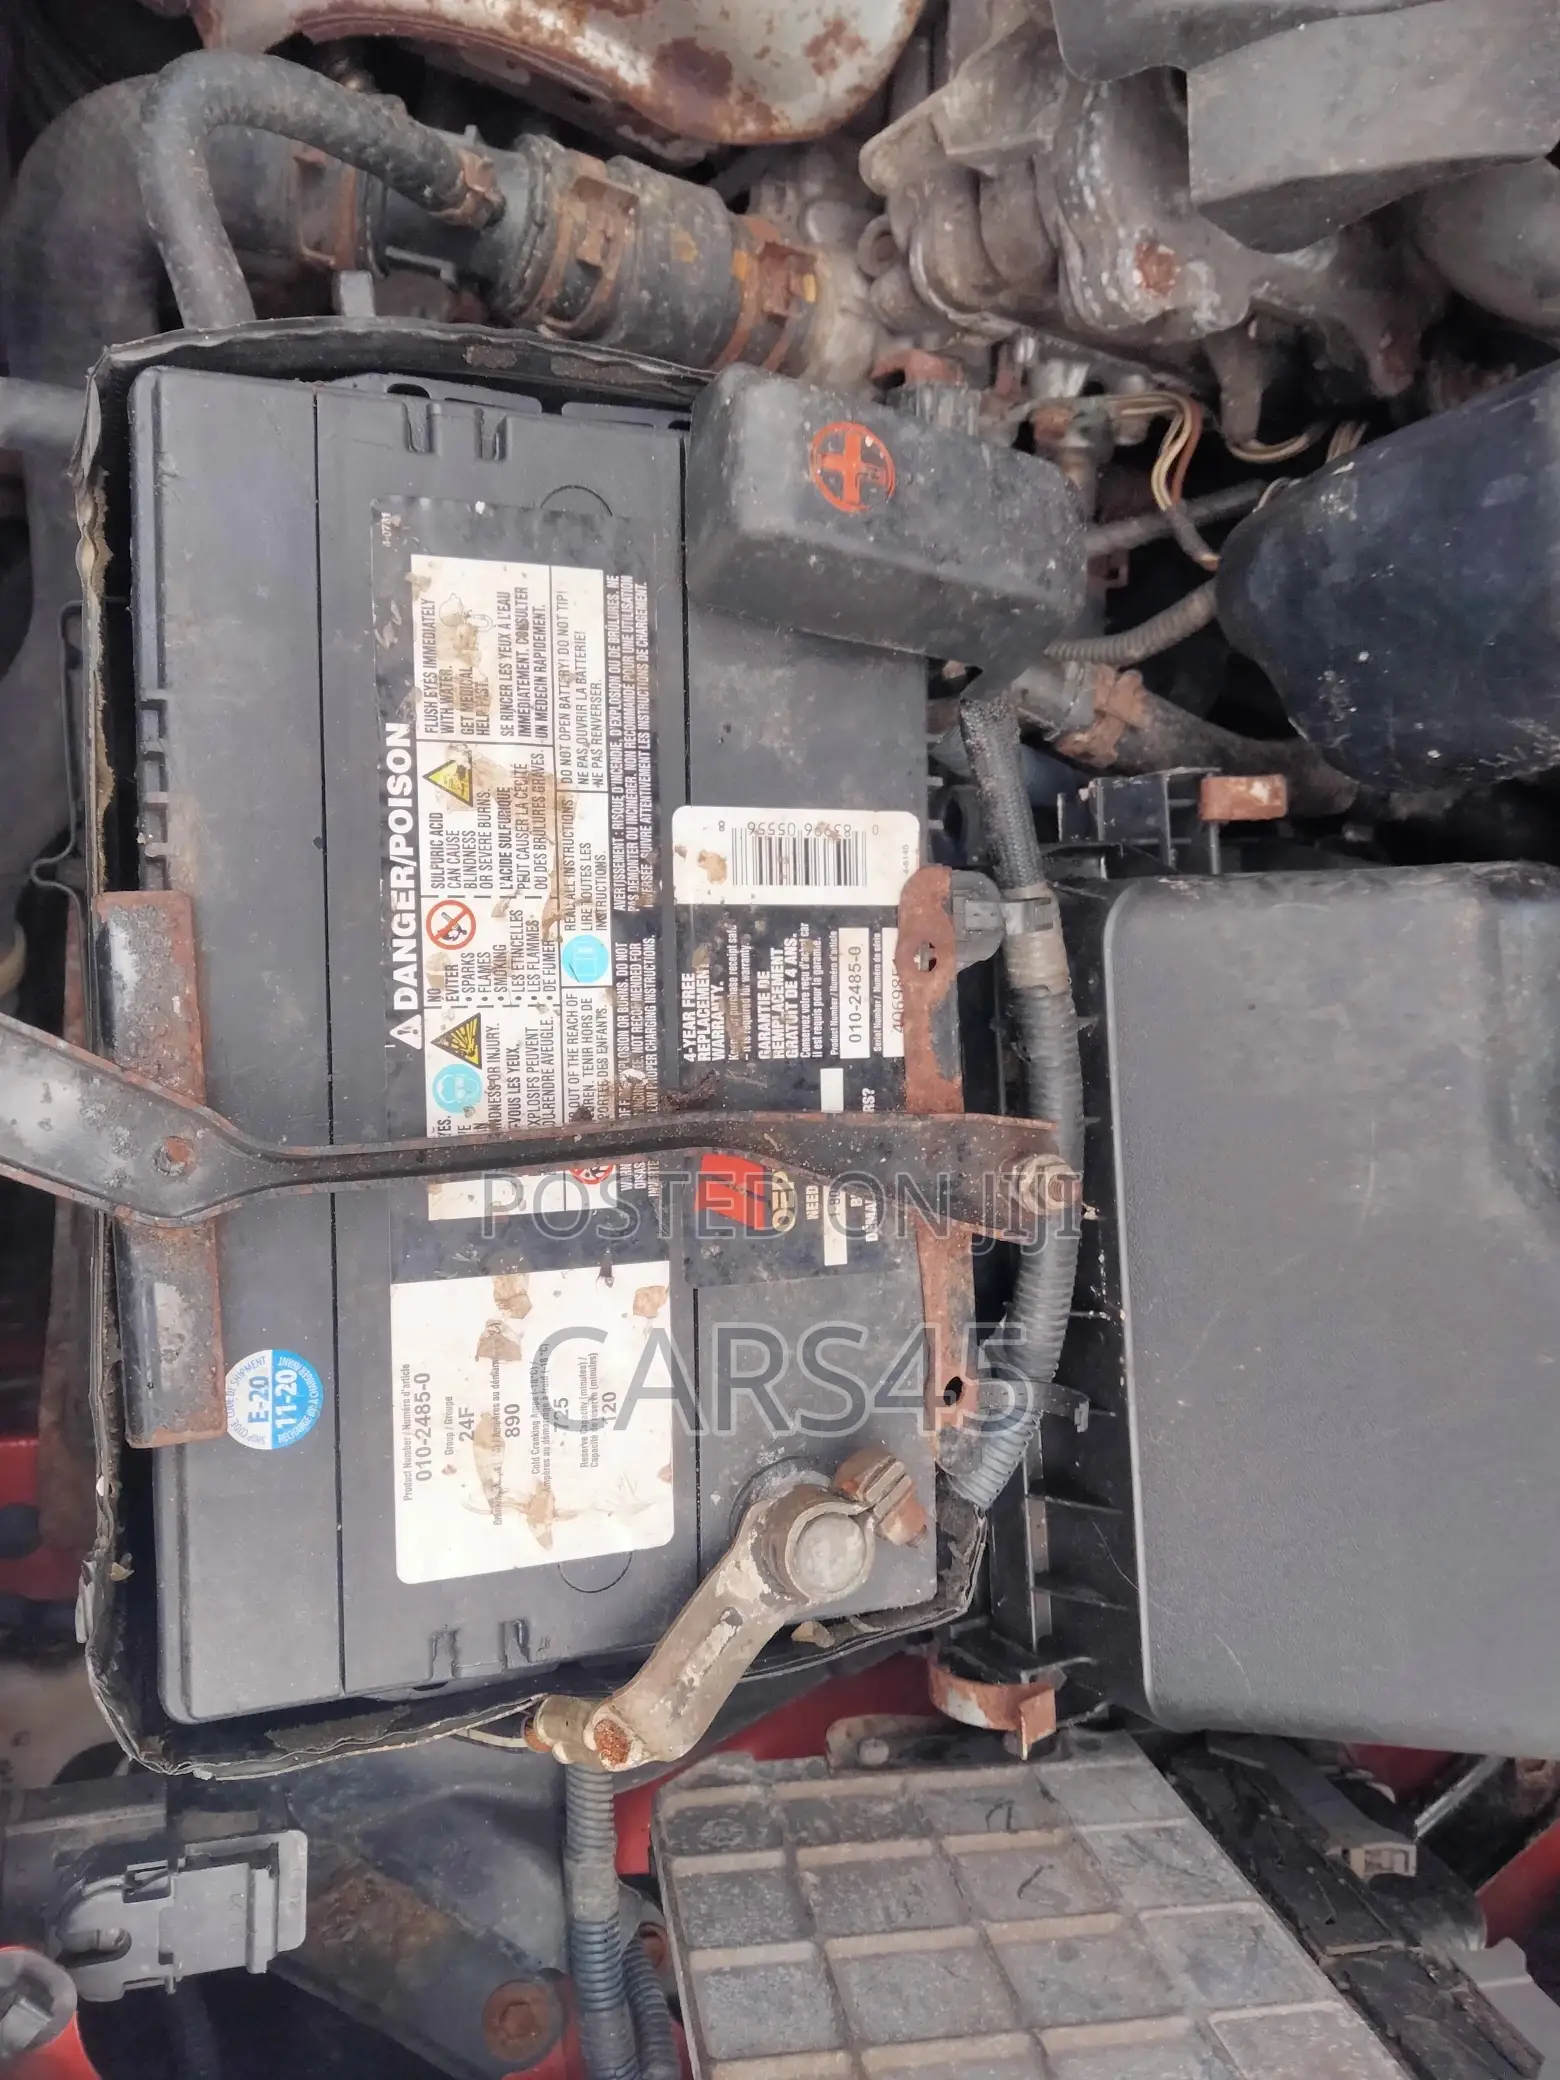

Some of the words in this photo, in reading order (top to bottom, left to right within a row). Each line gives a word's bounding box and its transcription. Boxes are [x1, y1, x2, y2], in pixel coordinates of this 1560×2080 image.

[606, 575, 620, 588] NE
[497, 591, 511, 620] L'EAU
[514, 586, 530, 645] CONSULTER
[556, 590, 568, 612] TIP!
[620, 575, 634, 632] UTILISATION
[634, 582, 648, 647] CHARGEMENT.
[420, 598, 436, 668] IMMEDIATELY
[532, 604, 548, 672] RAPIDEMENT.
[556, 614, 569, 636] NOT
[498, 632, 512, 659] YEUX
[556, 640, 569, 654] DO
[574, 630, 587, 684] BATTERIE!
[608, 646, 620, 658] DE
[622, 634, 634, 653] UNE
[636, 648, 648, 662] DE
[498, 662, 513, 681] LES
[608, 660, 621, 673] OU
[622, 655, 636, 681] POUR
[422, 672, 438, 698] EYES
[438, 666, 454, 704] WATER.
[459, 666, 474, 712] MEDICAL
[475, 677, 489, 707] FAST.
[512, 648, 532, 737] IMMÉDIATEMENT.
[557, 658, 571, 709] BATTERY!
[575, 688, 588, 700] LA
[636, 663, 650, 730] INSTRUCTIONS
[424, 702, 438, 734] FLUSH
[499, 684, 514, 721] RINCER
[590, 680, 603, 744] RENVERSER.
[608, 676, 622, 736] D'EXPLOSION
[440, 708, 454, 734] WITH
[460, 716, 474, 735] GET
[476, 712, 490, 736] HELP
[500, 724, 514, 736] SE
[534, 724, 548, 738] UN
[558, 712, 572, 740] OPEN
[575, 704, 588, 744] OUVRIR
[560, 744, 572, 766] NOT
[638, 732, 650, 749] LES
[530, 750, 546, 793] GRAVES.
[576, 748, 588, 768] PAS
[591, 748, 604, 768] PAS
[624, 750, 637, 770] NON
[510, 763, 528, 799] CÉCITÉ
[561, 770, 573, 783] DO
[578, 772, 590, 784] NE
[638, 750, 652, 824] ATTENTIVEMENT
[476, 788, 492, 828] BURNS.
[496, 786, 512, 848] SULFURIQUE
[515, 802, 528, 815] LA
[530, 796, 546, 850] BRÛLURES
[611, 795, 626, 830] RISQUE
[428, 812, 444, 836] ACID
[514, 818, 530, 860] CAUSER
[626, 827, 638, 840] OU
[747, 820, 796, 836] 05556
[446, 830, 460, 864] CAUSE
[462, 830, 478, 888] BLINDNESS
[478, 831, 492, 871] SEVERE
[533, 853, 548, 872] DES
[579, 842, 592, 860] LES
[386, 722, 418, 1010] DANGER/POISON
[430, 840, 446, 889] SULFURIC
[447, 868, 462, 888] CAN
[498, 852, 514, 890] L'ACIDE
[516, 863, 530, 890] PEUT
[611, 836, 626, 911] AVERTISSEMENT
[479, 874, 493, 889] OR
[534, 876, 548, 890] OU
[563, 881, 576, 900] ALL
[580, 864, 592, 905] TOUTES
[594, 850, 608, 931] INSTRUCTIONS.
[580, 908, 592, 931] LIRE
[800, 922, 810, 936] car
[525, 920, 540, 970] FLAMMES
[614, 942, 628, 960] NOT
[630, 942, 642, 962] FOR
[726, 944, 739, 974] receipt
[784, 932, 798, 965] ANS.
[460, 952, 476, 993] SPARKS
[476, 952, 492, 992] FLAMES
[492, 944, 508, 992] SMOKING
[511, 974, 526, 992] LES
[526, 974, 540, 992] LES
[616, 963, 628, 976] DO
[642, 934, 656, 1004] INSTRUCTIONS.
[756, 970, 770, 989] DE
[784, 968, 798, 978] 4
[426, 988, 442, 1002] NO
[542, 978, 556, 992] DE
[566, 993, 578, 1006] OF
[616, 980, 630, 1012] BURNS.
[682, 972, 696, 1008] FREE
[728, 976, 742, 1016] purchase
[784, 980, 798, 998] DE
[814, 988, 824, 1006] pour
[848, 946, 862, 1043] 010-2485-0
[581, 998, 594, 1012] DE
[696, 963, 711, 1061] REPLACEMENT
[770, 948, 786, 1059] REMPLACEMENT
[800, 992, 810, 1012] votre
[829, 998, 838, 1026] Number
[566, 1008, 578, 1044] REACH
[582, 1014, 594, 1044] HORS
[594, 1004, 608, 1054] ENFANTS.
[644, 1004, 657, 1052] CHARGING
[710, 981, 726, 1060] WARRANTY.
[756, 992, 771, 1060] GARANTIE
[784, 1002, 800, 1058] GRATUIT
[800, 1014, 811, 1058] Conservez
[813, 1008, 824, 1034] requis
[486, 1023, 500, 1063] INJURY.
[525, 1028, 540, 1073] PEUVENT
[540, 1016, 554, 1066] AVEUGLE.
[631, 1032, 644, 1053] NOT
[682, 1011, 697, 1062] 4-YEAR
[813, 1036, 823, 1050] est
[566, 1048, 579, 1068] THE
[582, 1047, 594, 1078] TENIR
[596, 1058, 608, 1078] DES
[508, 1076, 520, 1094] LES
[541, 1069, 555, 1108] RENDRE
[568, 1071, 580, 1084] OF
[568, 1088, 580, 1108] OUT
[806, 1185, 820, 1220] NEED
[230, 1356, 266, 1386] SHIPMENT
[578, 1362, 588, 1400] (minutes)
[588, 1352, 599, 1390] (minutes)
[248, 1376, 269, 1423] E-20
[274, 1369, 298, 1428] 11-20
[444, 1396, 454, 1424] Groupe
[601, 1392, 617, 1424] 120
[414, 1372, 432, 1481] 010-2485-0
[458, 1406, 475, 1442] 24F
[504, 1404, 520, 1438] 890
[554, 1398, 568, 1432] 725
[579, 1402, 590, 1434] Capacity
[402, 1437, 412, 1468] Number
[444, 1432, 454, 1455] Group
[530, 1420, 542, 1454] Cranking
[580, 1436, 589, 1468] Reserve
[590, 1435, 600, 1468] Capacité
[530, 1456, 540, 1474] Cold
[403, 1470, 413, 1501] Product
